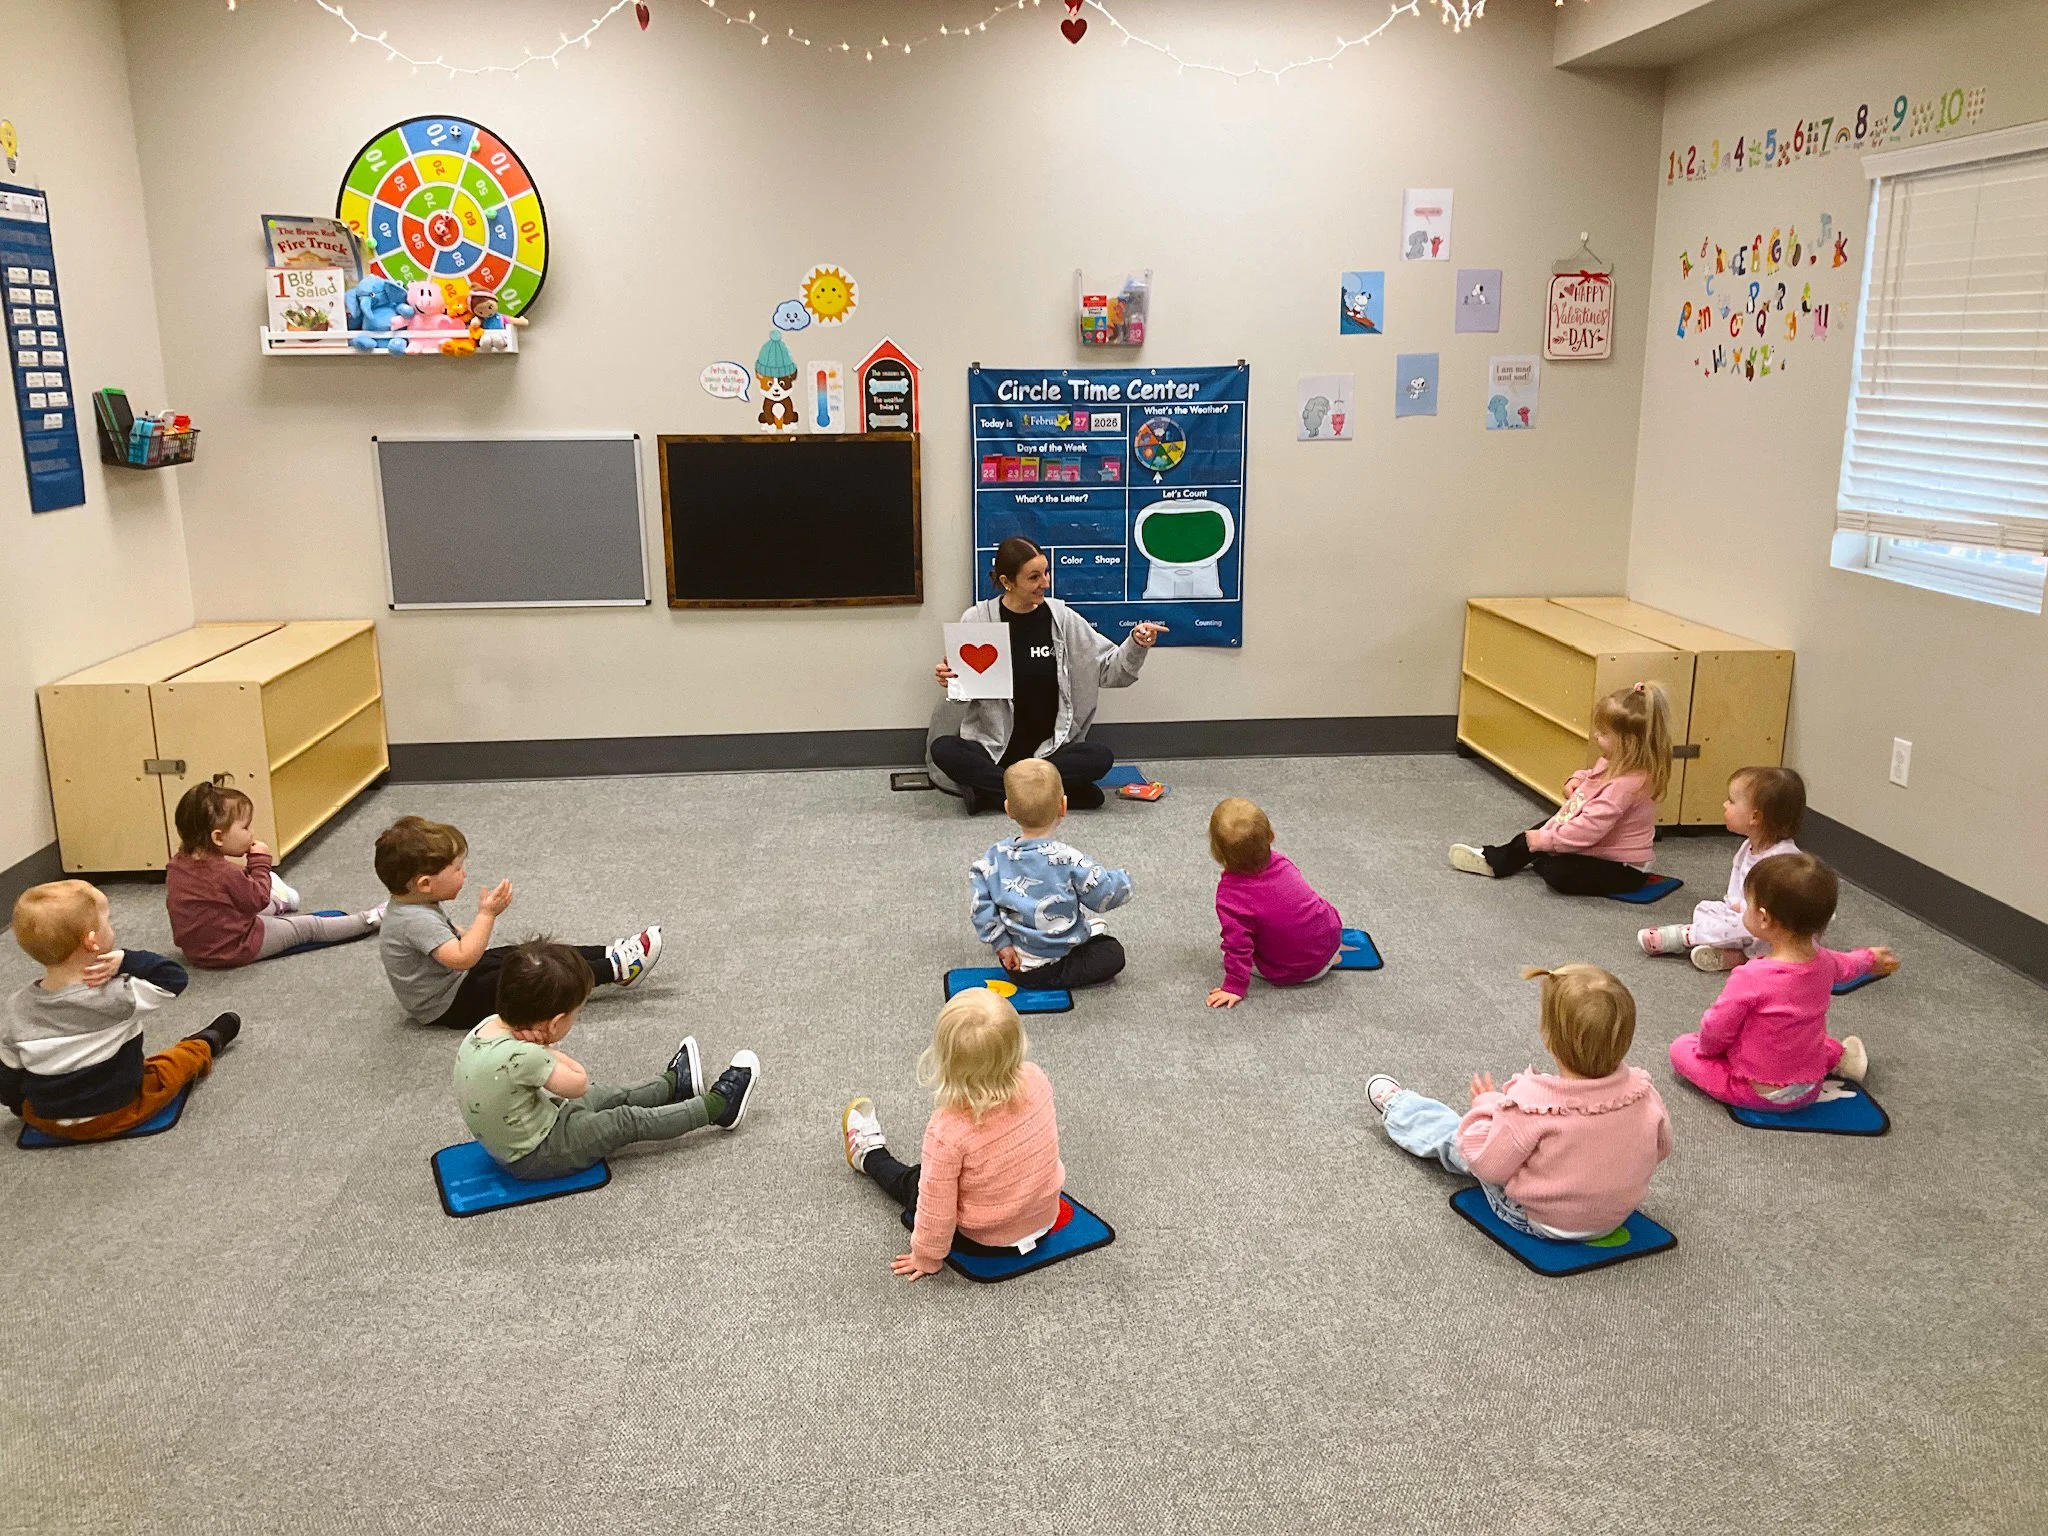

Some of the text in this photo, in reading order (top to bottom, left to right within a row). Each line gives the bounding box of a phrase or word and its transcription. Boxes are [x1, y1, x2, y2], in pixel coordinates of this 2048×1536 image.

[426, 123, 448, 147] 10
[1687, 145, 1696, 175] 2
[1711, 139, 1720, 170] 3
[1734, 136, 1744, 166] 4
[1764, 128, 1778, 162] 5
[1794, 118, 1804, 152] 6
[1821, 116, 1834, 151] 7
[1855, 104, 1868, 140] 8
[1892, 94, 1908, 132] 9
[1938, 88, 1964, 128] 10
[365, 148, 387, 173] 10
[432, 160, 446, 176] 20
[490, 151, 511, 177] 10
[394, 175, 408, 192] 50
[475, 178, 488, 196] 50
[424, 191, 437, 209] 70
[378, 222, 392, 238] 40
[494, 224, 507, 240] 40
[520, 220, 541, 245] 10
[277, 236, 348, 255] Fire Truck
[451, 251, 466, 268] 80
[287, 270, 314, 287] Big
[480, 266, 494, 284] 30
[273, 272, 290, 298] 1
[296, 280, 337, 298] Salad
[1574, 285, 1605, 303] HAPPY
[500, 288, 522, 311] 10
[1568, 328, 1601, 352] DAY
[998, 378, 1200, 402] Circle Time Center
[1144, 404, 1228, 415] What's the Weather?
[980, 418, 1004, 430] Today
[1006, 418, 1013, 428] is
[1074, 418, 1086, 426] 27
[1094, 418, 1118, 428] 2026
[1016, 442, 1088, 454] Days of the Week
[983, 469, 994, 478] 22
[1008, 470, 1019, 478] 23
[1024, 470, 1035, 478] 24
[1015, 494, 1089, 504] What's the Letter?
[1162, 489, 1208, 498] Let's Count
[1060, 555, 1120, 566] Color Shape
[1194, 619, 1223, 628] Counting
